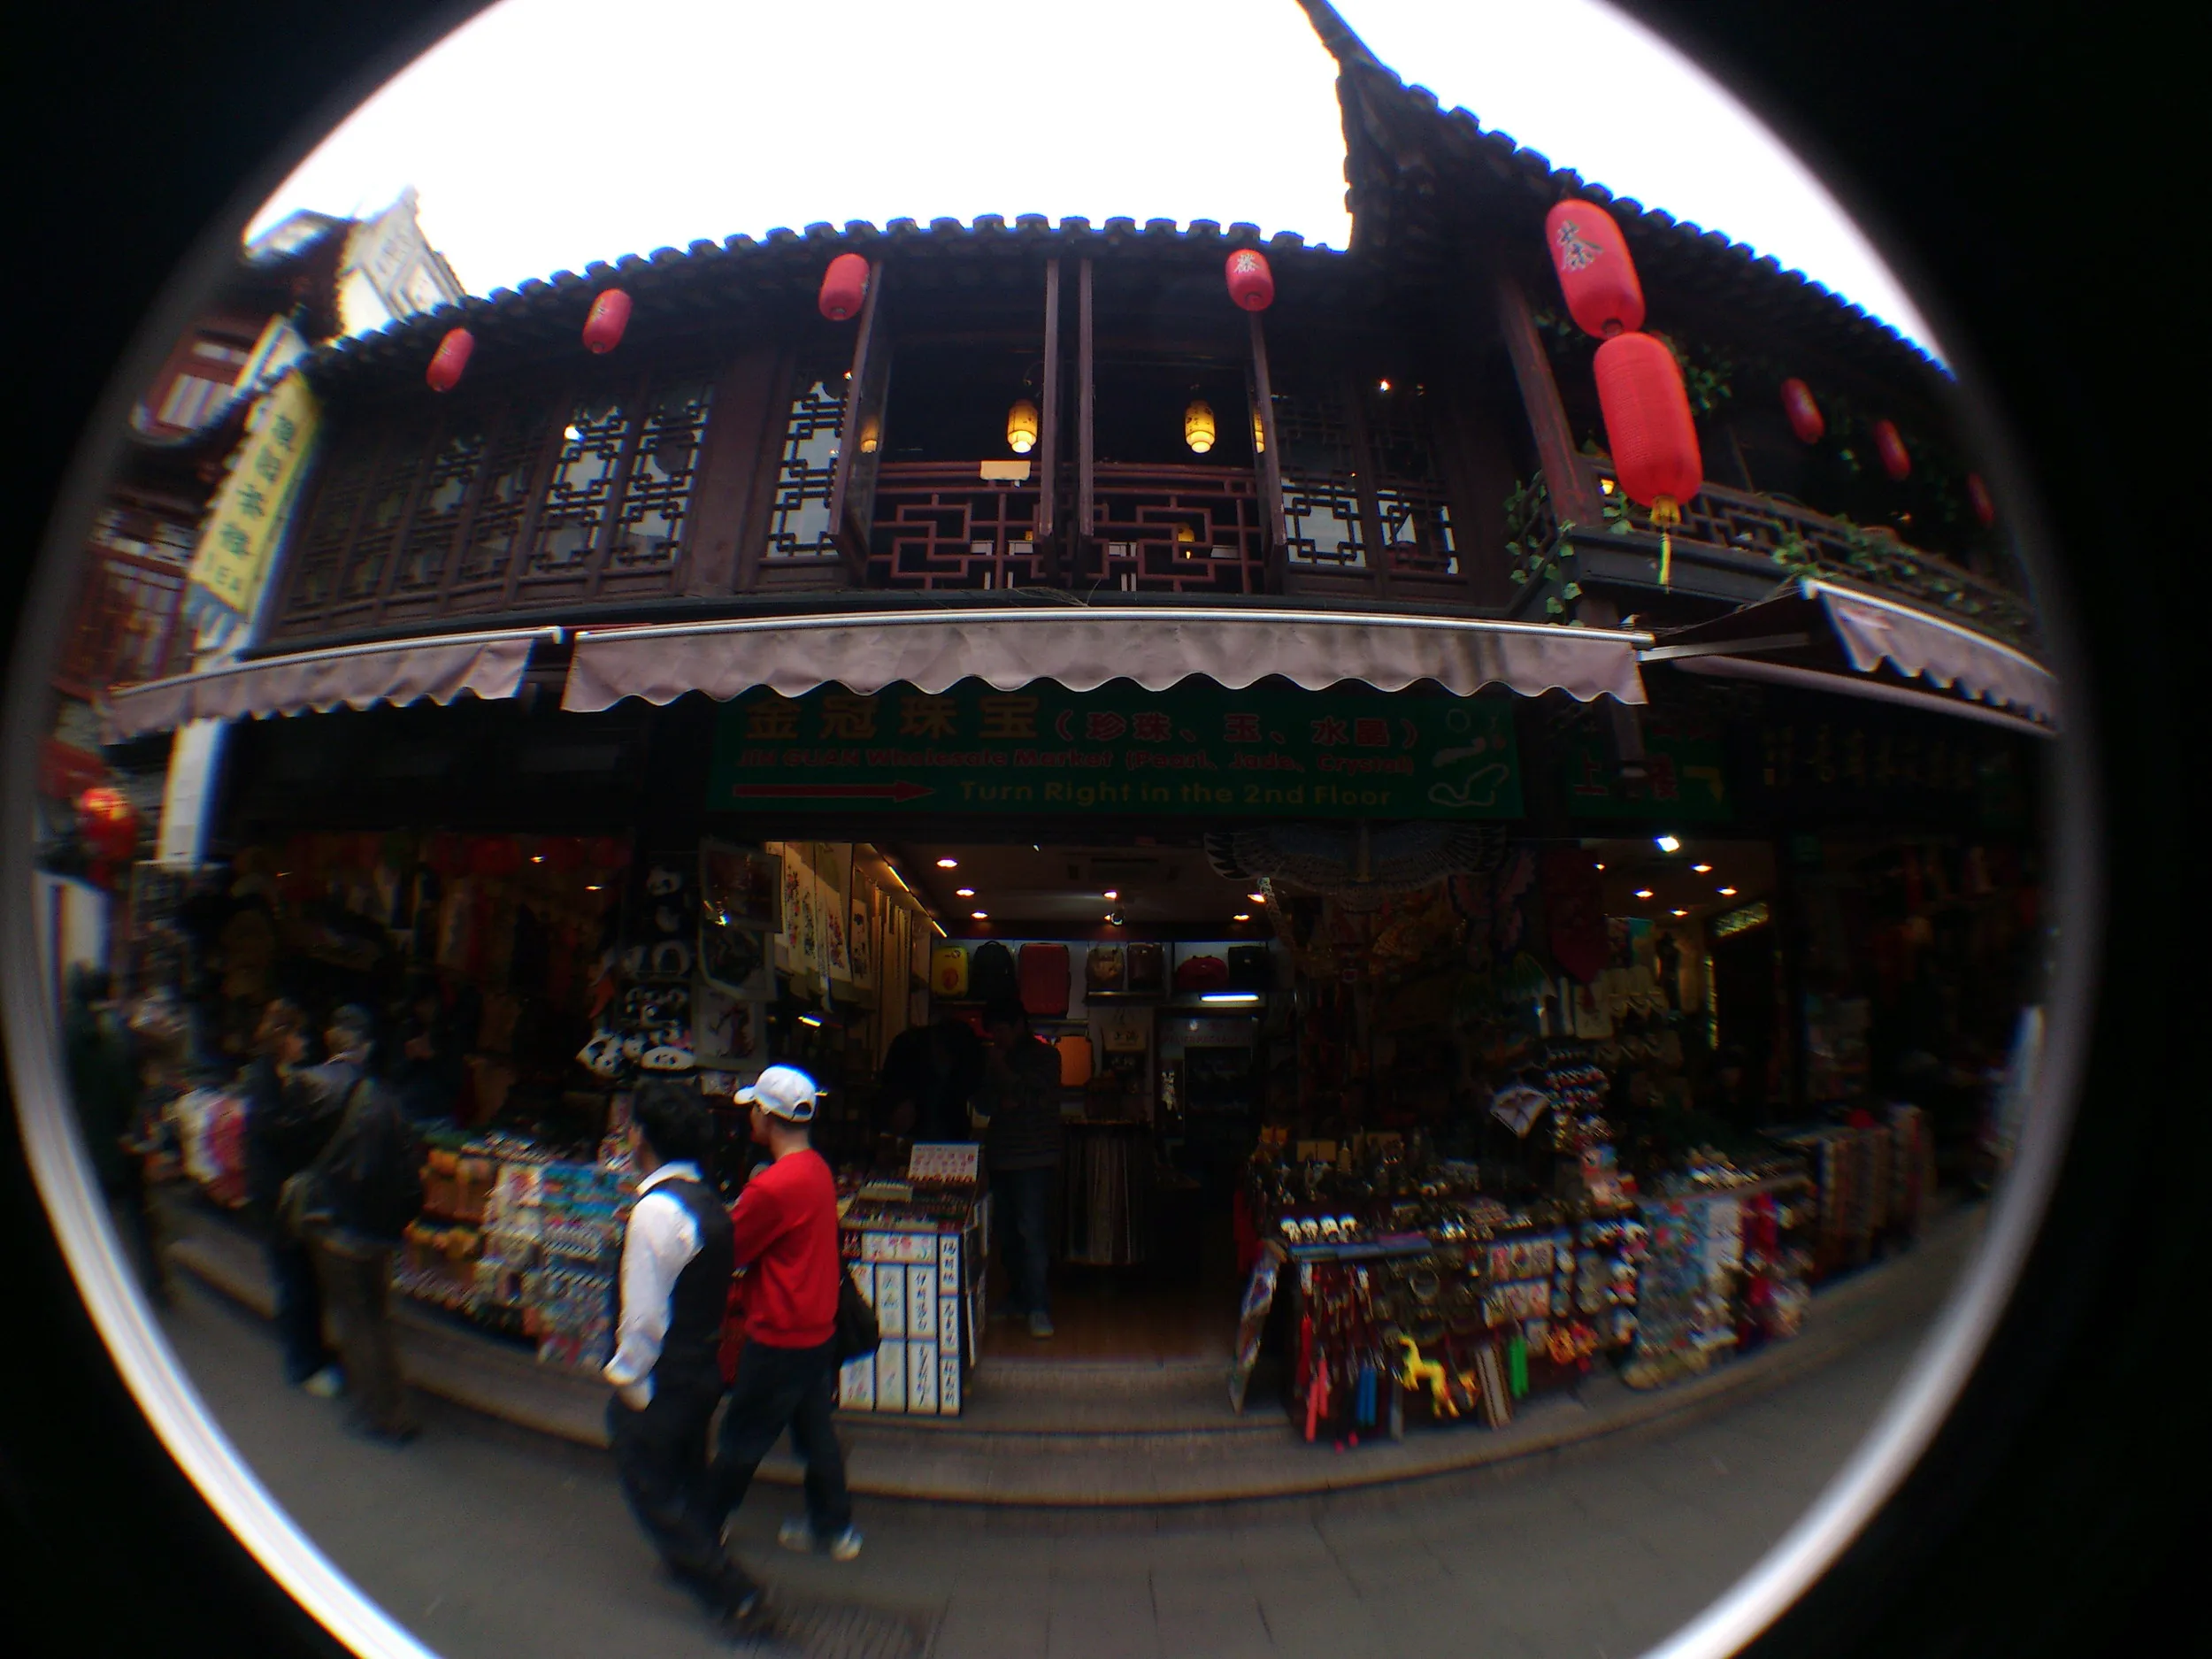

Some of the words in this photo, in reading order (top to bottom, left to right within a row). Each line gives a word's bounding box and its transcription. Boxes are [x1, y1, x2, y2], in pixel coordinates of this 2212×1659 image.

[744, 695, 1041, 741] 金冠珠宝
[736, 749, 776, 768] JIN
[782, 749, 861, 767] GUAN
[865, 748, 1009, 767] Wholesale
[1014, 748, 1113, 768] Market
[1317, 752, 1416, 775] Crystal)
[958, 780, 1033, 802] Turn
[1043, 780, 1132, 807] Right
[1179, 781, 1234, 803] the
[1242, 782, 1305, 804] 2nd
[1313, 784, 1392, 807] Floor
